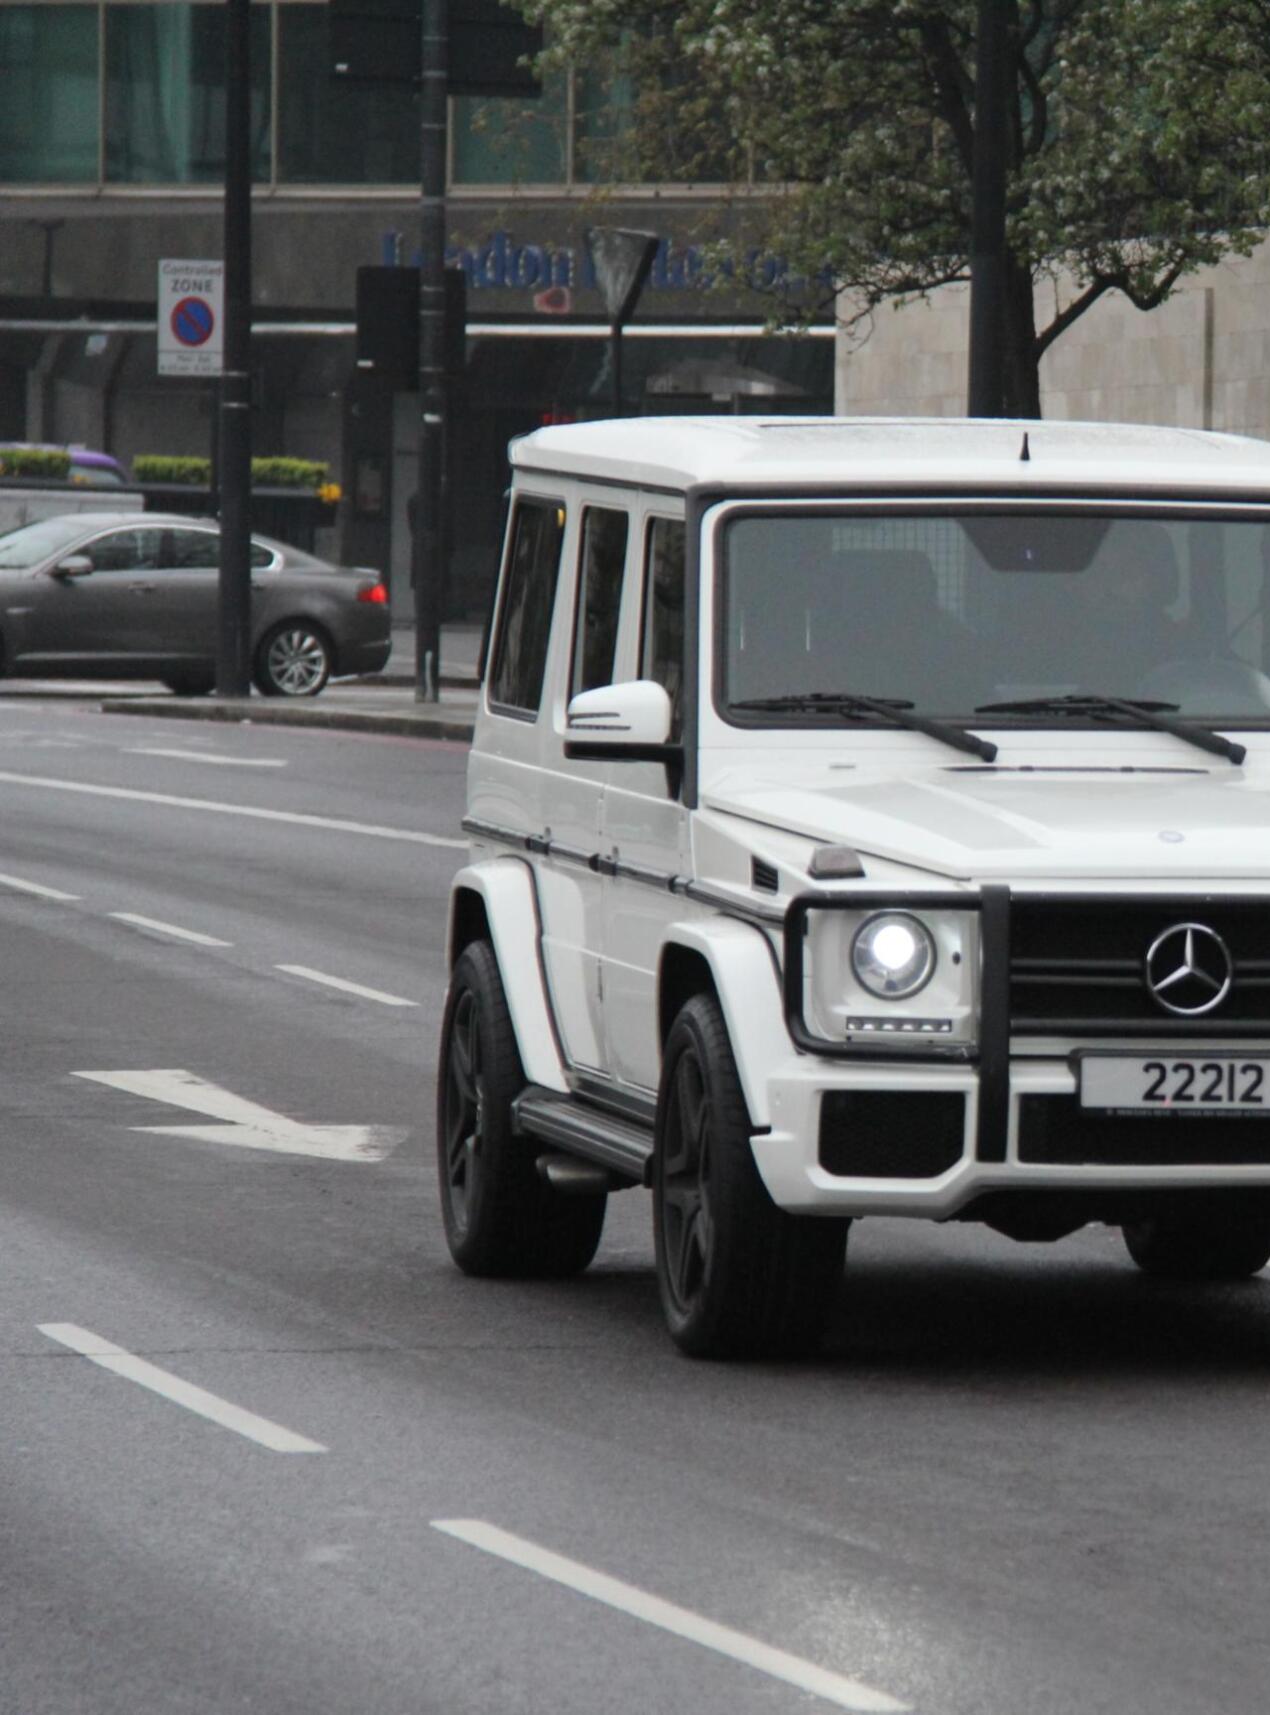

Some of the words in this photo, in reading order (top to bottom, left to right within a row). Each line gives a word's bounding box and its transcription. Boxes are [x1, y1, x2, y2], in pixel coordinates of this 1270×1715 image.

[384, 230, 574, 288] Lndon
[171, 279, 214, 293] ZONE
[1142, 1062, 1263, 1102] 22212
